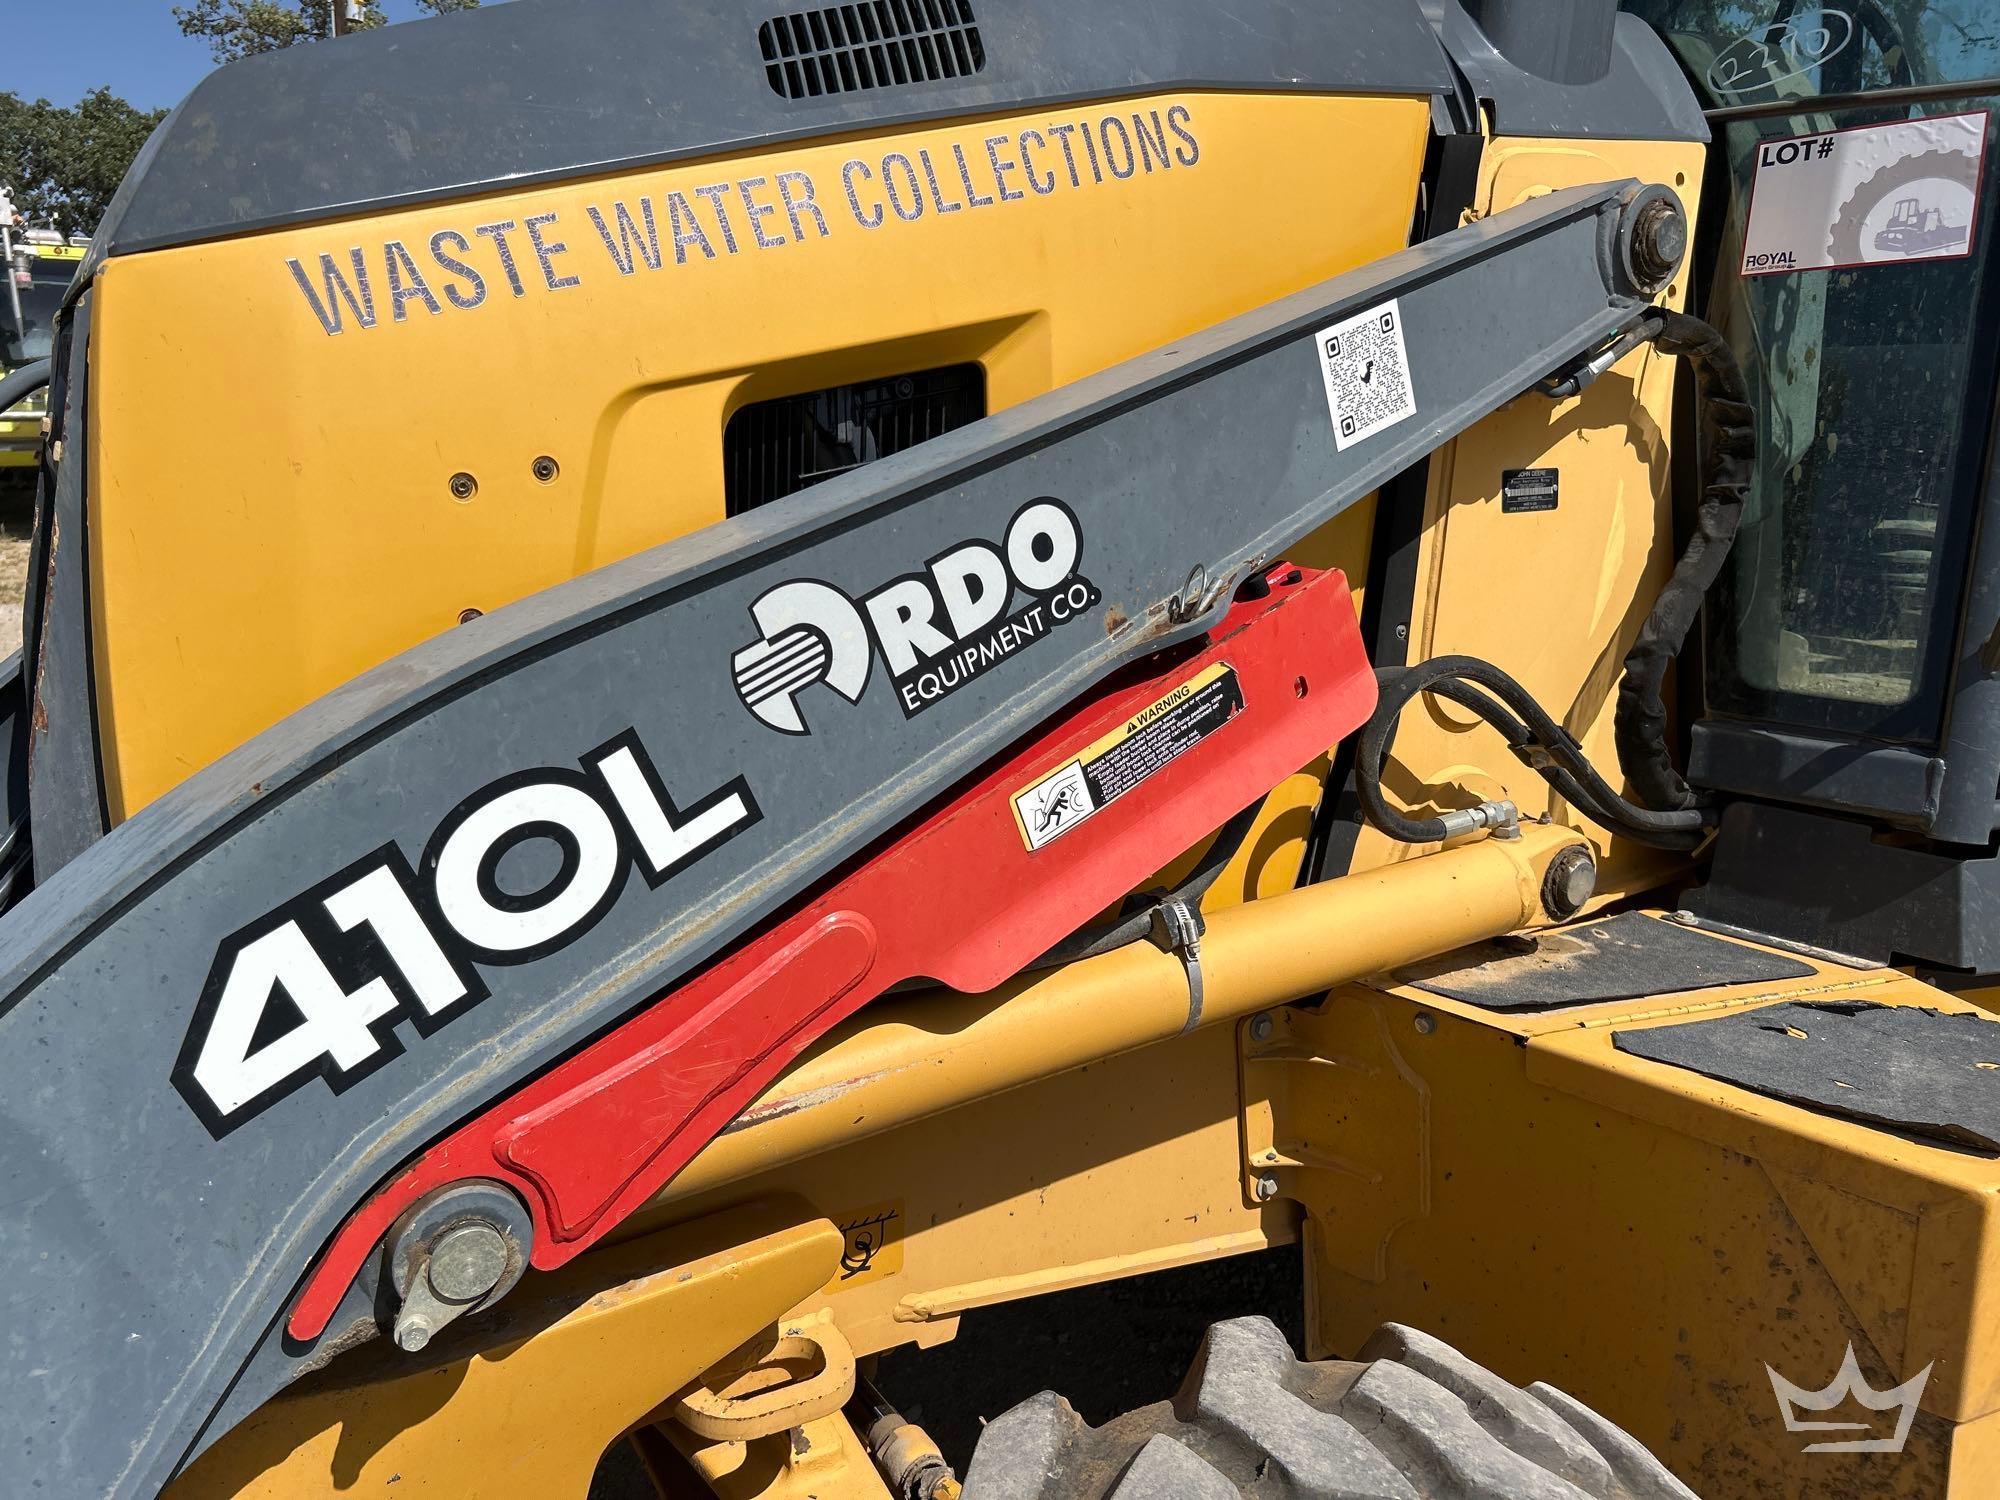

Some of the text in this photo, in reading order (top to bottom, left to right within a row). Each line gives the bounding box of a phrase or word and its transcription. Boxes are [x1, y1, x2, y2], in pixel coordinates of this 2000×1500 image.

[1761, 137, 1835, 168] LOT#
[285, 105, 1200, 336] WASTE WATER COLLECTIONS
[1746, 251, 1796, 267] ROYAL
[901, 583, 1096, 710] EQUIPMENT CO.
[1137, 685, 1190, 726] WARNING
[193, 746, 748, 1116] 410L
